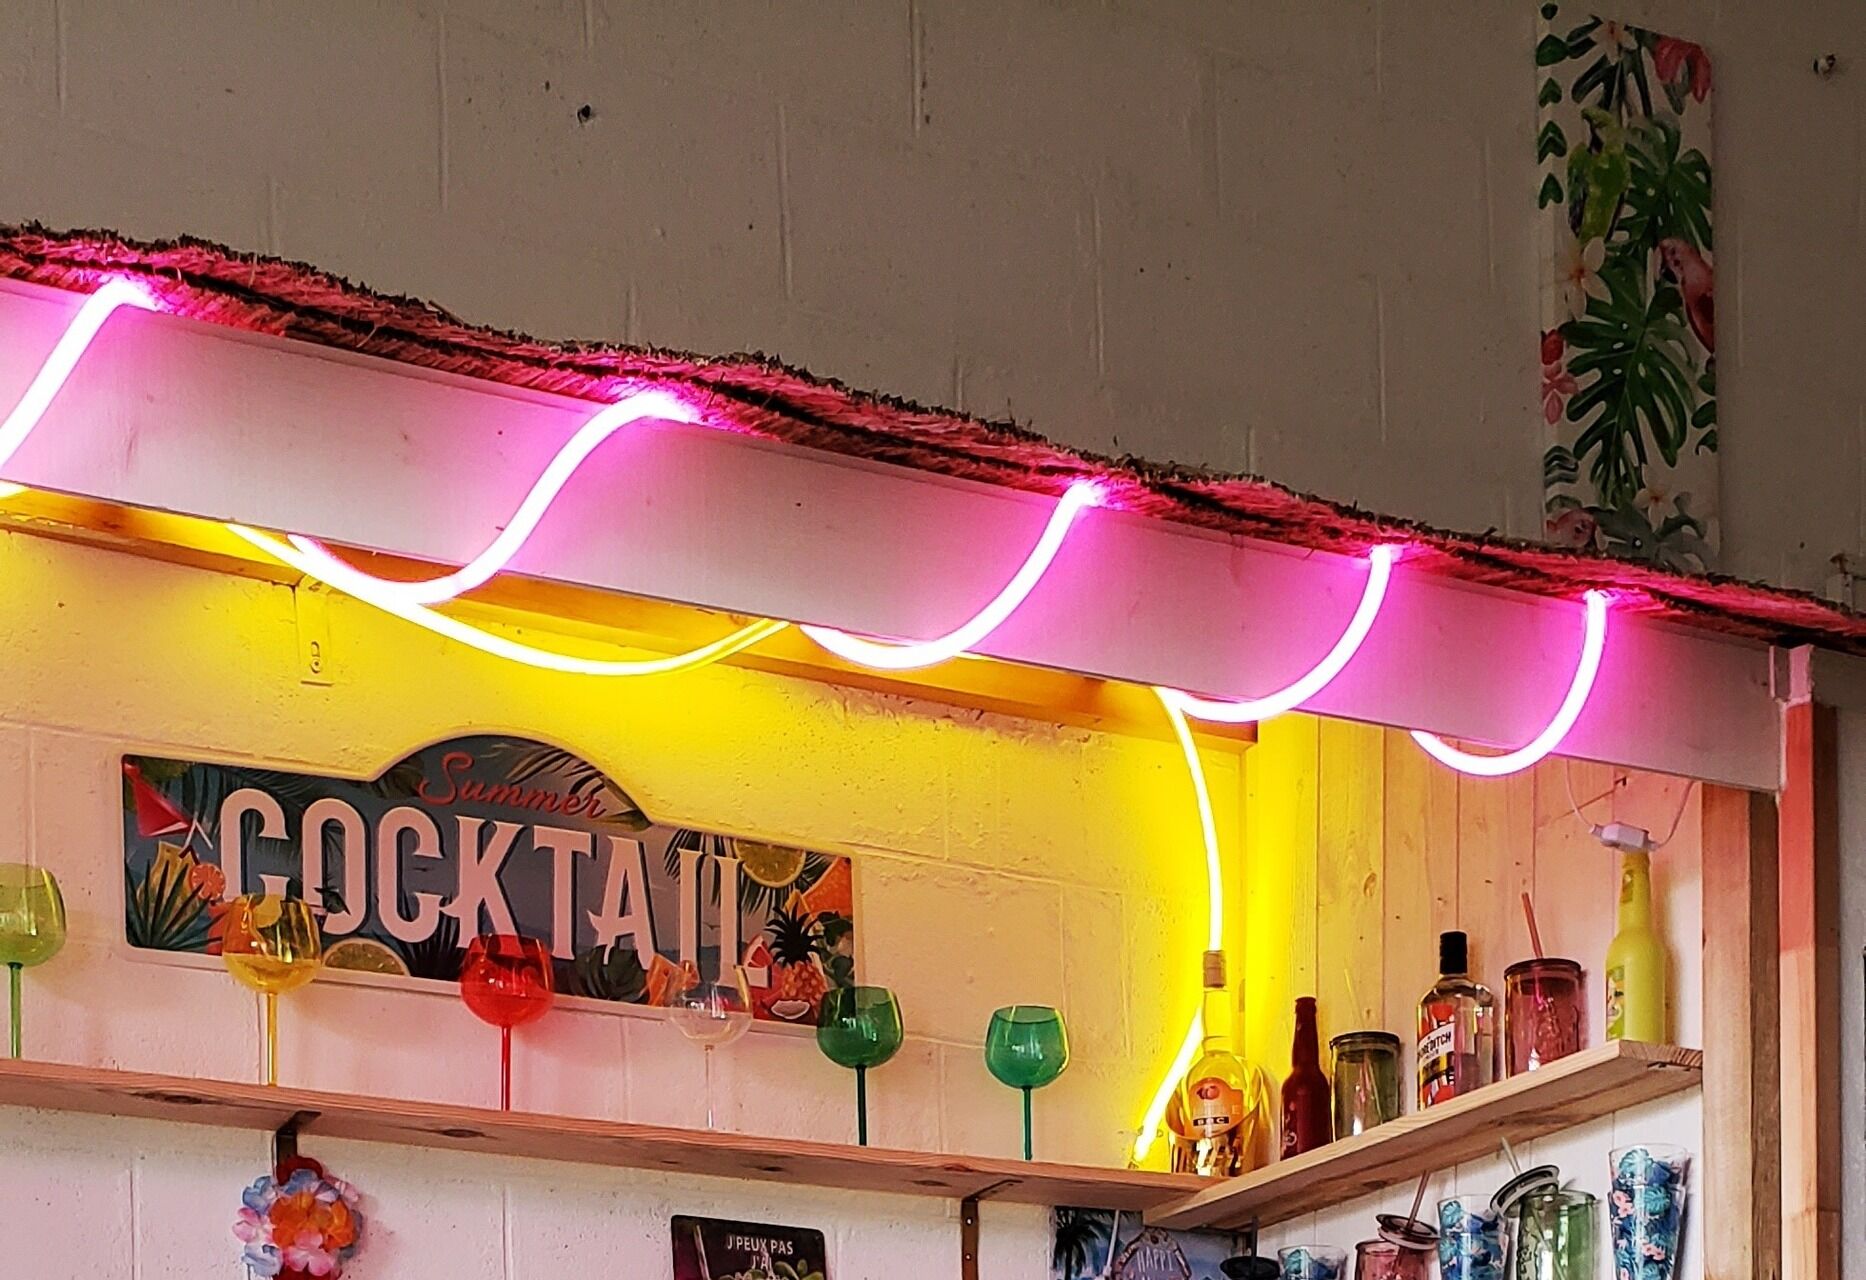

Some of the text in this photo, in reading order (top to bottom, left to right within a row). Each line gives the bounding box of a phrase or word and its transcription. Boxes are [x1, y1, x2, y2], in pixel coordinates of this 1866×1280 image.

[416, 751, 607, 820] Summer
[220, 788, 769, 988] COCKTAIL
[770, 1239, 794, 1255] PAS
[1136, 1246, 1174, 1273] HAPPI
